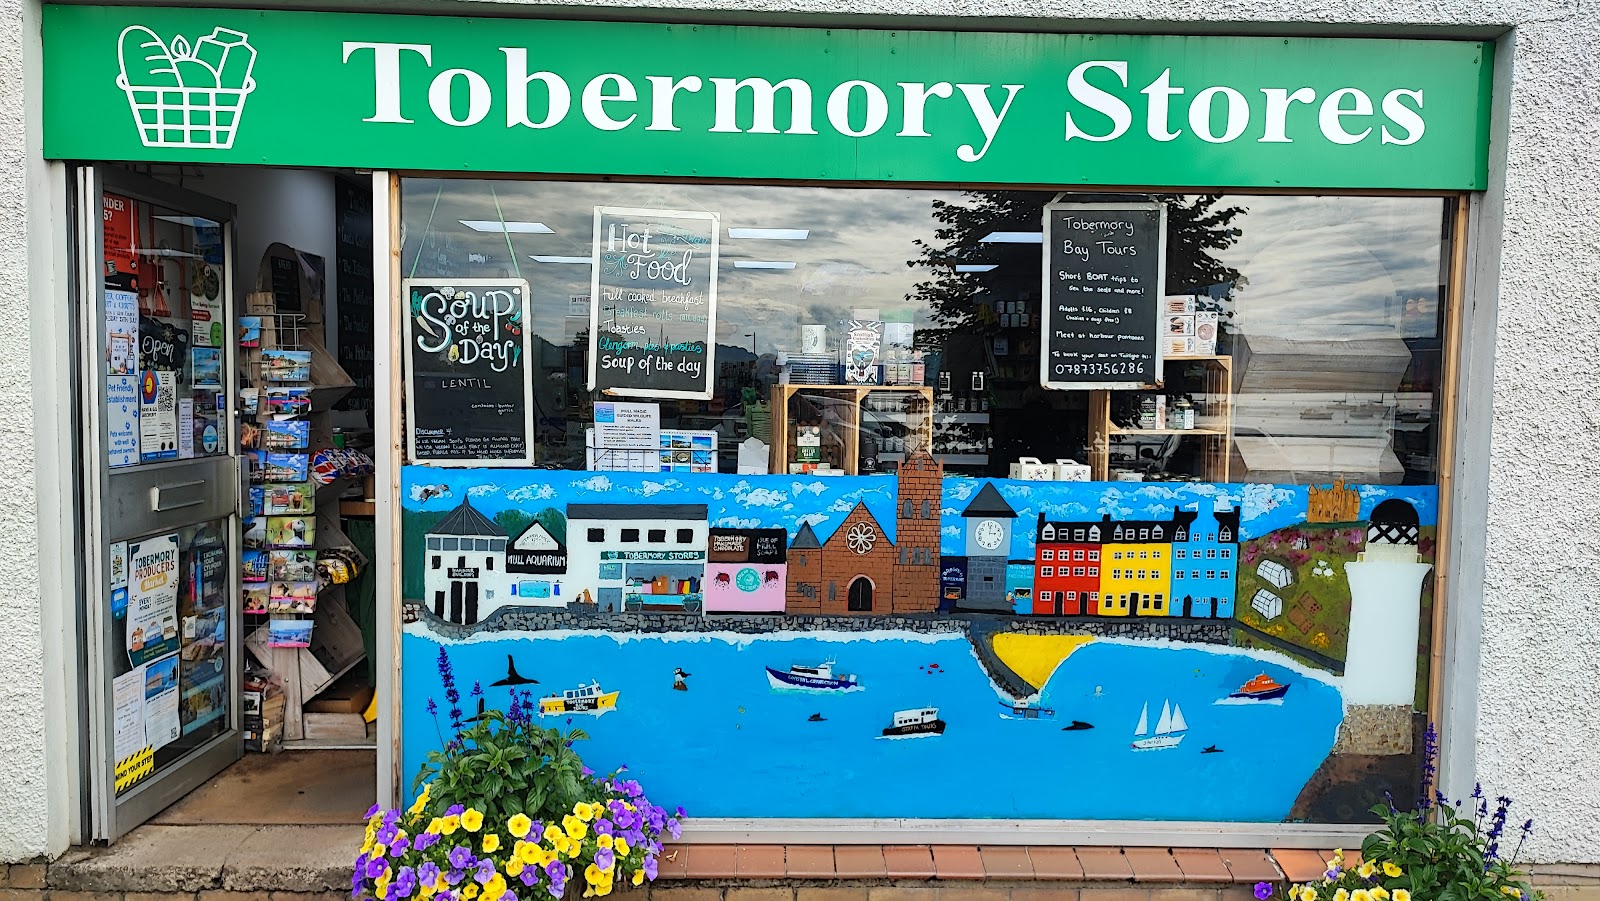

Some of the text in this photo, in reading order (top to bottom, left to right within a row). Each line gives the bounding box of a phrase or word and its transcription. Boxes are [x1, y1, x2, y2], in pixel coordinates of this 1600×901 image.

[343, 41, 1425, 163] Tobermory Stores
[103, 197, 124, 211] NDER
[104, 210, 113, 221] 5?
[1062, 216, 1135, 237] Tobermory
[606, 223, 653, 254] Hot
[1063, 239, 1137, 262] Bay Tours
[626, 249, 693, 286] Food
[1059, 270, 1082, 281] Short
[1086, 271, 1109, 281] BOAT
[1110, 275, 1127, 285] trips
[627, 289, 705, 311] cooked breakfast
[1126, 287, 1145, 298] more!
[603, 304, 673, 321] Breakfast rolls
[1058, 304, 1079, 313] Adults
[417, 290, 516, 353] Soup
[455, 320, 492, 336] of the
[602, 319, 646, 335] Toasties
[1055, 330, 1075, 339] Meet
[142, 335, 174, 362] Open
[598, 336, 639, 356] Glengorm
[643, 341, 662, 355] pies
[670, 340, 703, 354] pasties
[458, 338, 515, 373] Day
[1051, 350, 1061, 358] To
[1081, 353, 1095, 361] your
[601, 354, 701, 379] Soup of the day
[1055, 362, 1145, 375] 07873756286
[108, 384, 134, 394] Pet Friendly
[441, 377, 492, 389] LENTIL
[134, 549, 175, 570] TOBERMORY
[507, 554, 566, 567] MULL AQUARIUM
[624, 551, 700, 560] TOBERMORY STORES
[134, 560, 175, 582] PRODUCERS
[203, 560, 222, 572] CYLINDER
[138, 596, 152, 607] EVERY
[115, 754, 153, 781] MIND YOUR STEP
